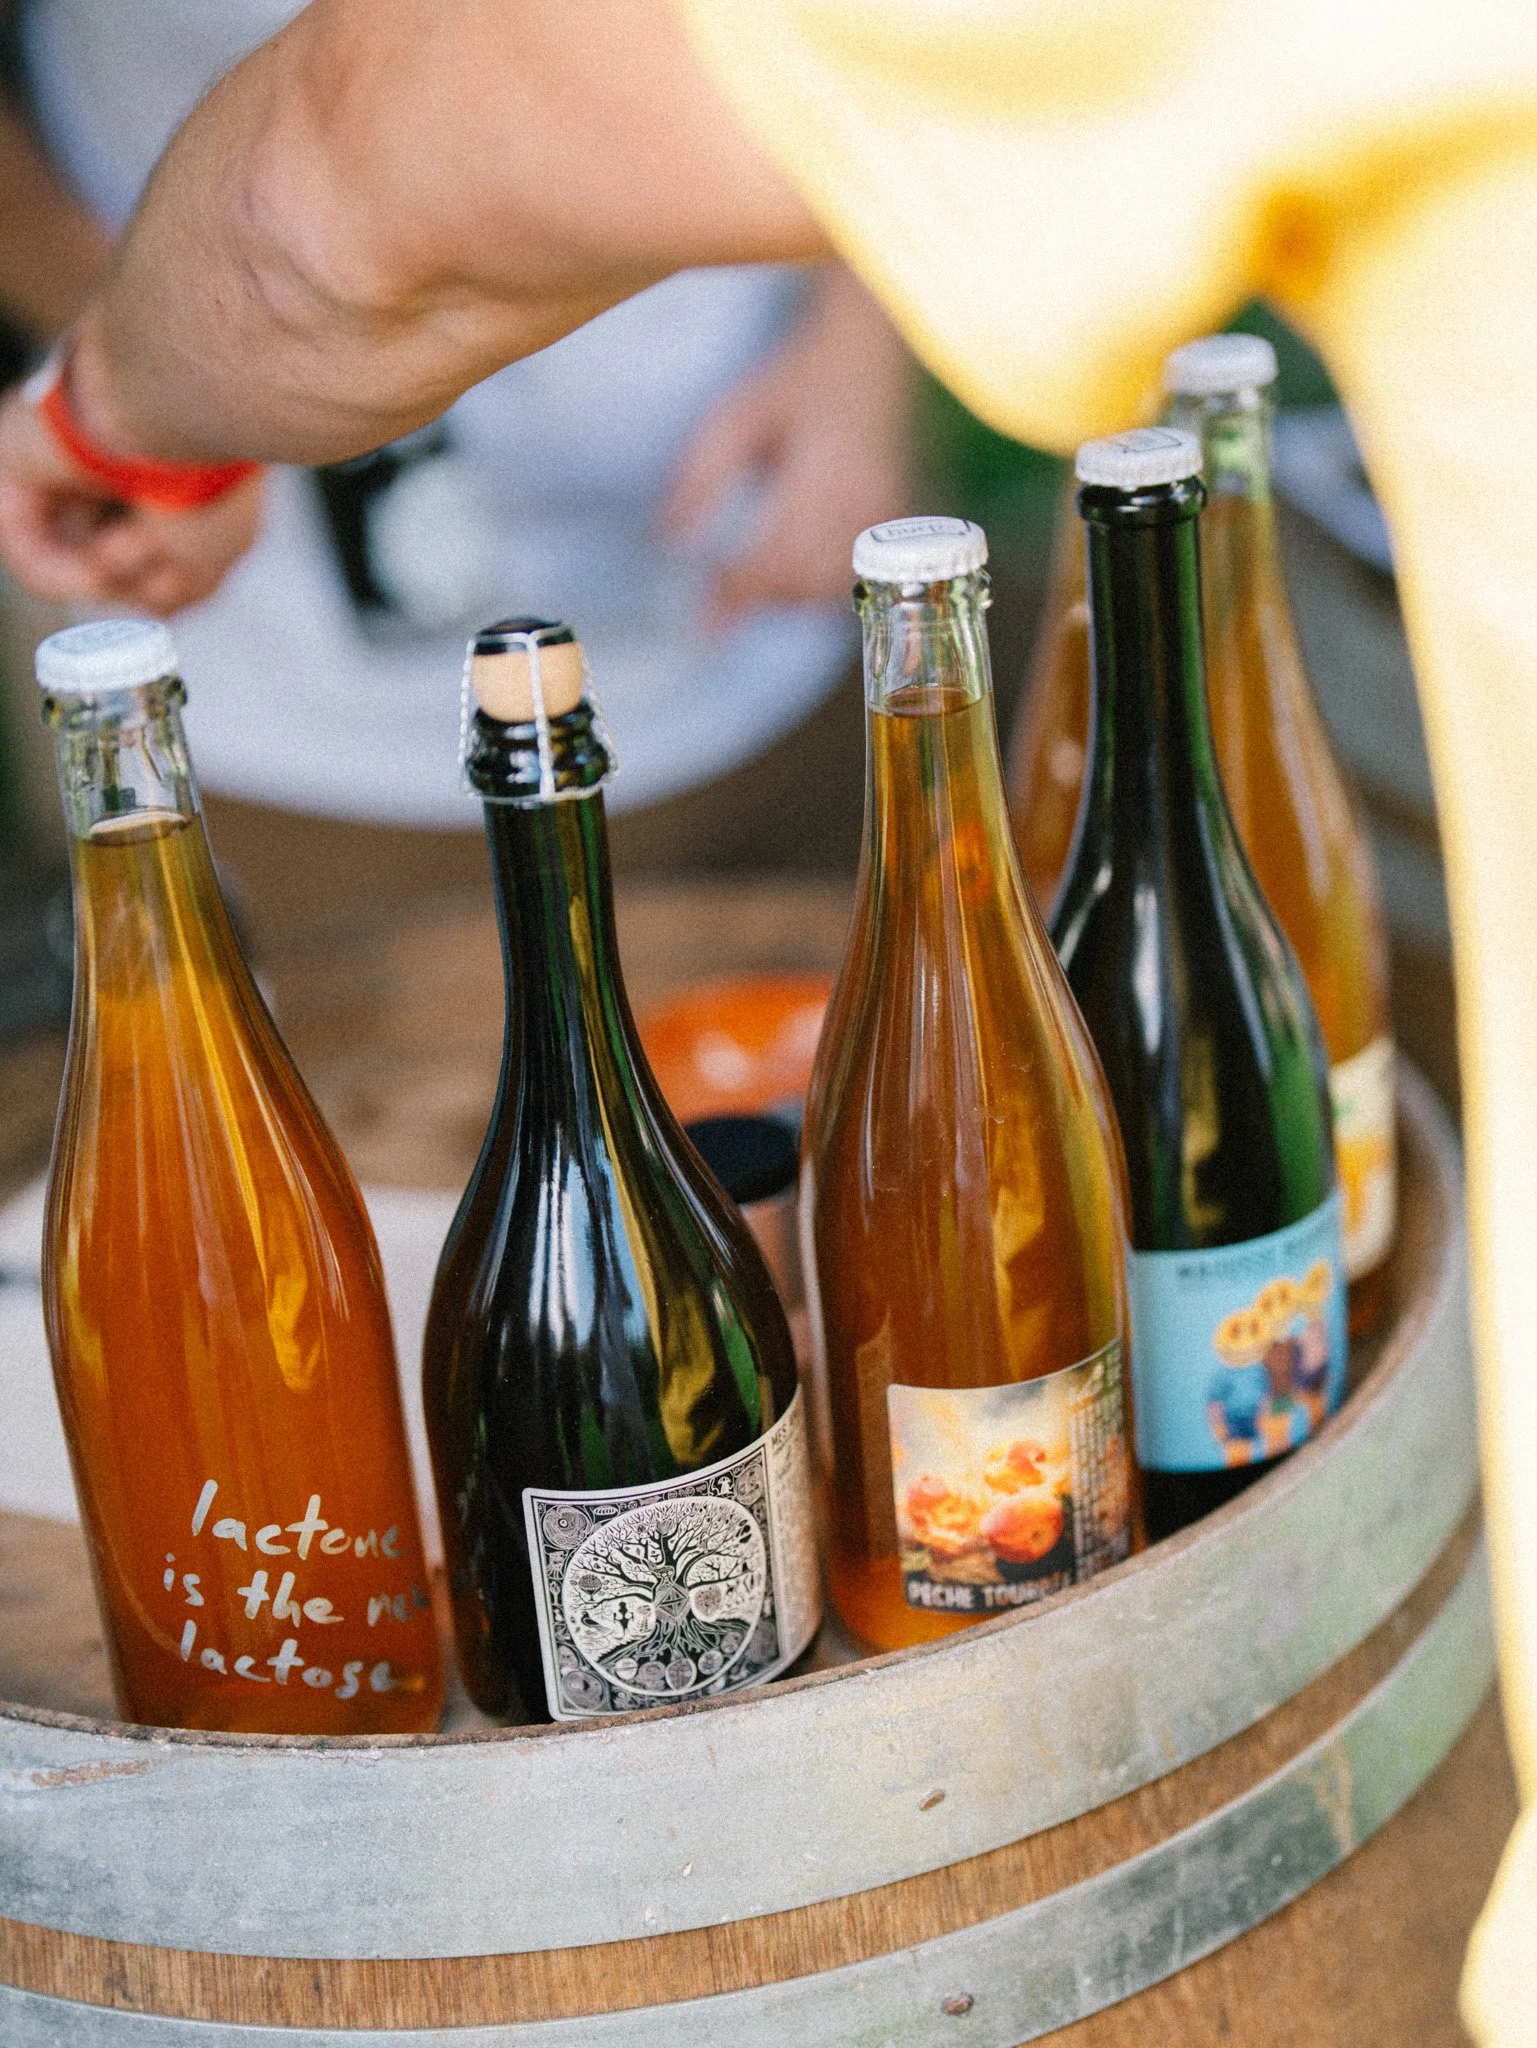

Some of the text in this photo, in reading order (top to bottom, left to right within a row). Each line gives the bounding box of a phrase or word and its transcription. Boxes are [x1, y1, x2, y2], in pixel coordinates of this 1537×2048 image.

[192, 1479, 404, 1560] lactone
[163, 1553, 204, 1606] is
[237, 1570, 344, 1628] the
[180, 1619, 398, 1699] lactose
